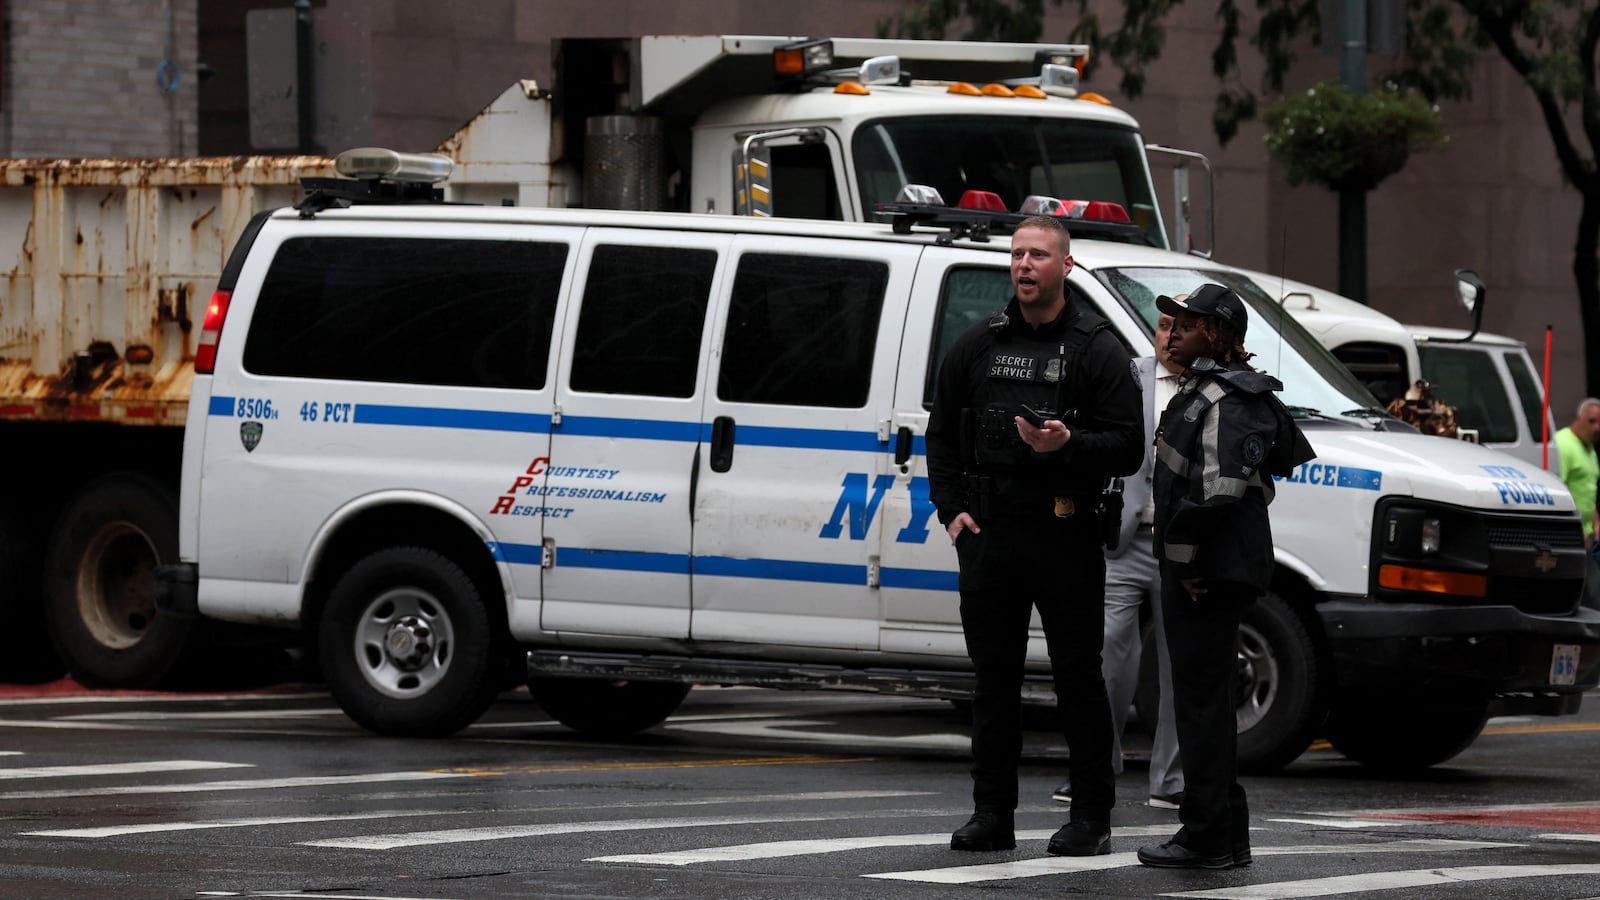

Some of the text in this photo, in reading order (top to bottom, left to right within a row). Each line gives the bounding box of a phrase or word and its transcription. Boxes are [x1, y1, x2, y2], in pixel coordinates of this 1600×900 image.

[991, 366, 1033, 379] SERVICE
[995, 355, 1034, 368] SECRET
[237, 398, 272, 419] 8506
[300, 401, 351, 423] 46 PCT
[526, 457, 620, 480] COURTESY
[507, 476, 668, 503] PROFESSIONALISM
[1491, 481, 1555, 506] POLICE
[489, 496, 575, 518] RESPECT
